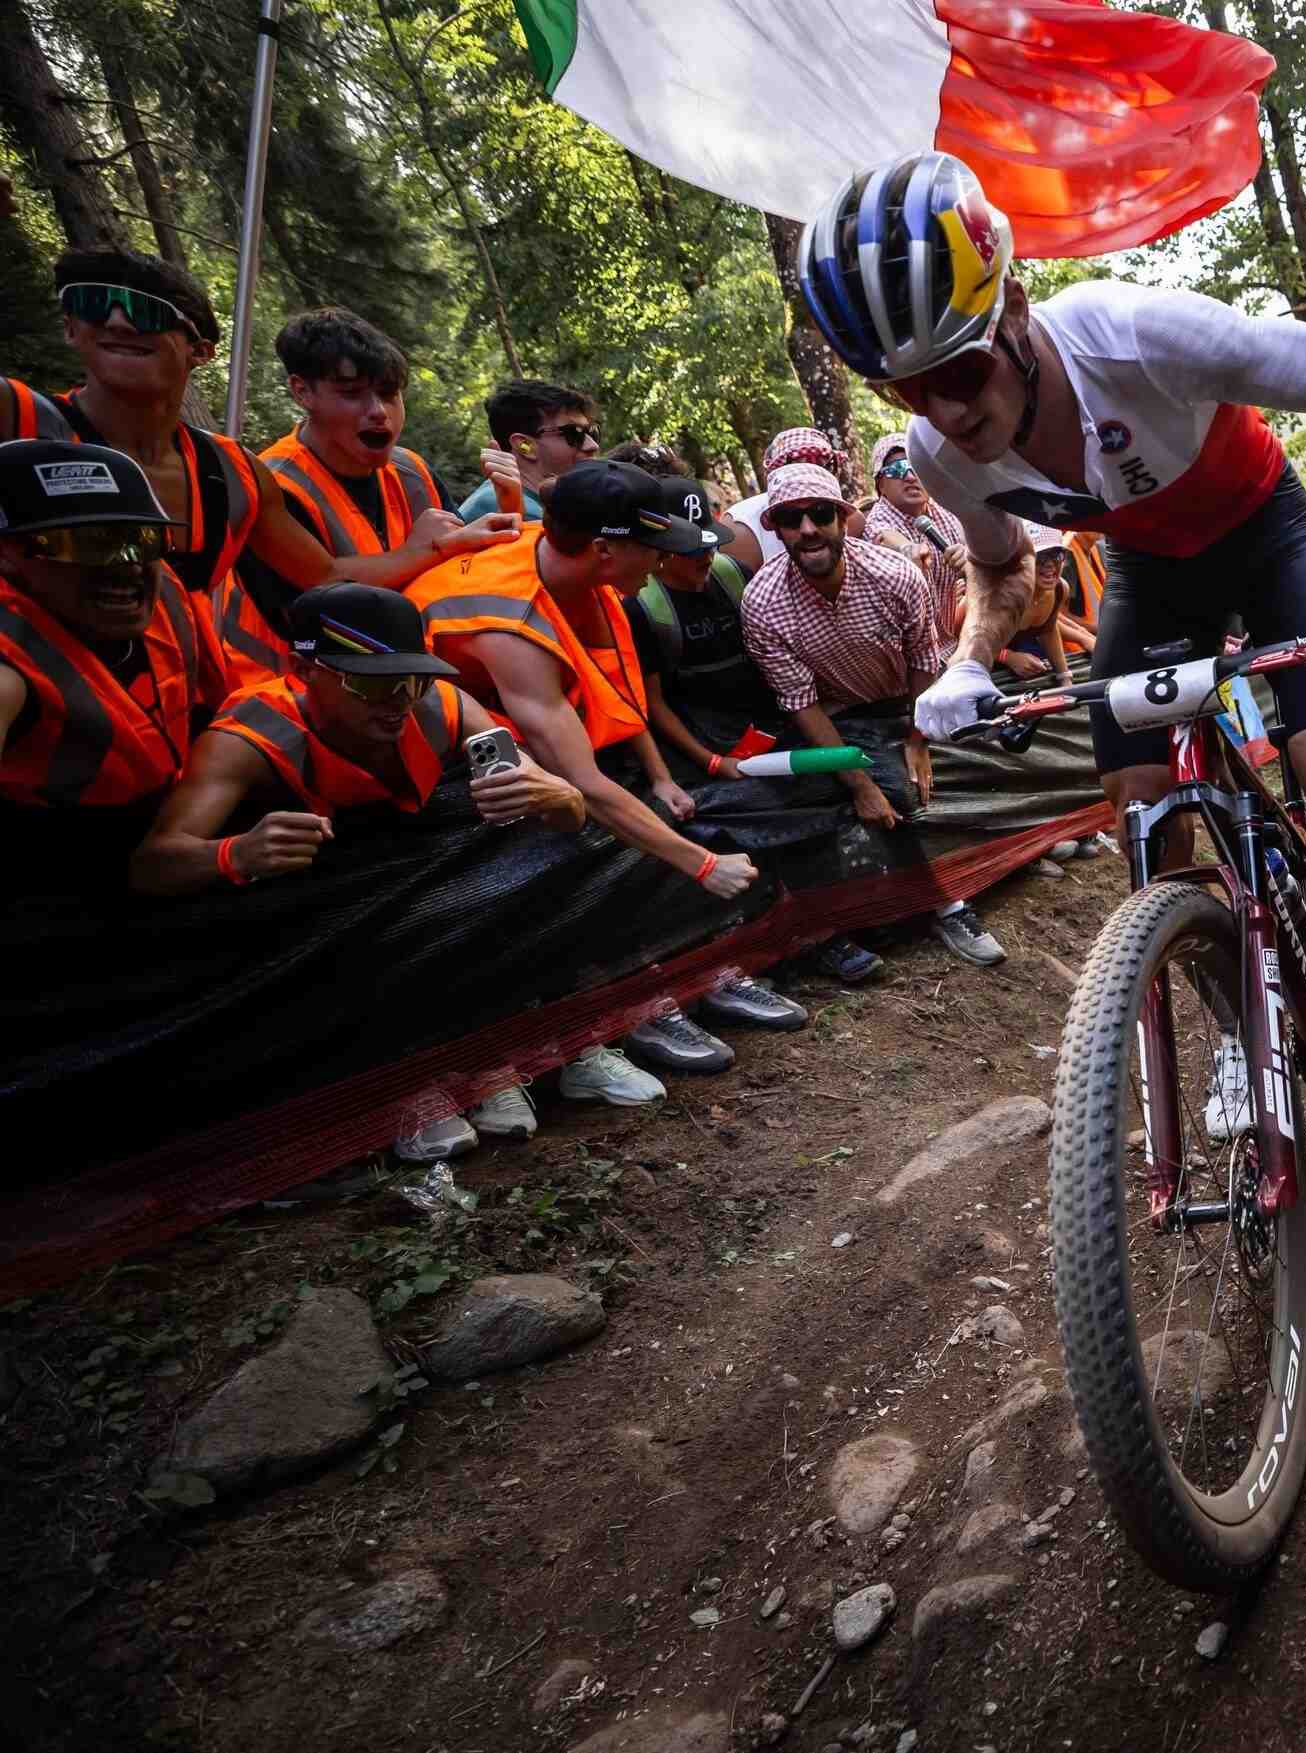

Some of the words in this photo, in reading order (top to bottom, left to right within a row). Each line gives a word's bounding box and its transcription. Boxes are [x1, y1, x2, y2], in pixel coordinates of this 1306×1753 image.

[1119, 456, 1158, 495] CHI
[683, 494, 703, 522] B
[1145, 668, 1179, 704] 8
